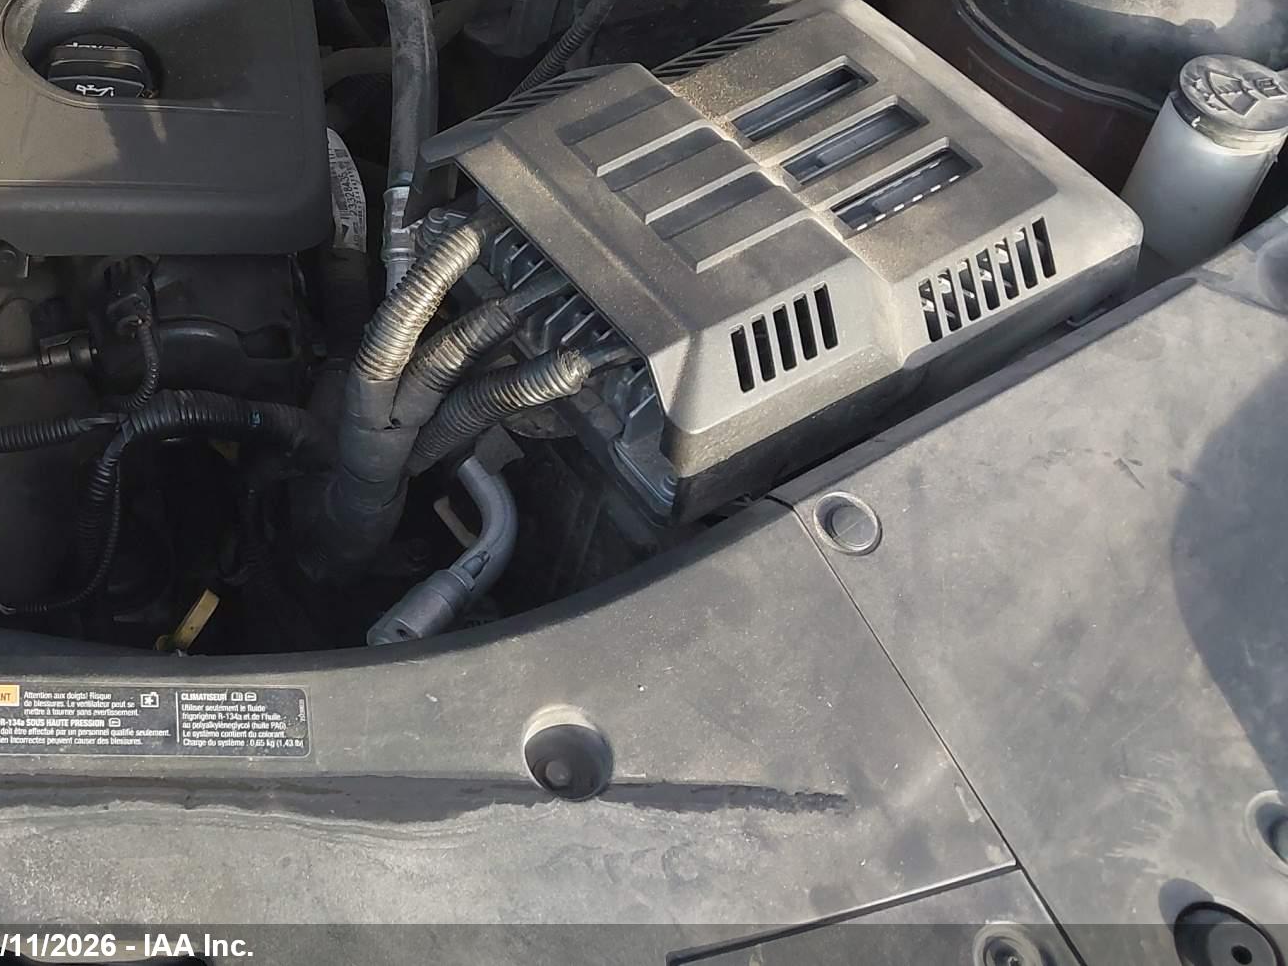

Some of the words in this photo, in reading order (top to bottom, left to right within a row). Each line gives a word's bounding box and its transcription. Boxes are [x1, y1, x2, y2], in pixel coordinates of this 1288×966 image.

[90, 692, 111, 700] Risque
[0, 718, 25, 726] R-134a
[70, 719, 104, 727] PRESSION
[78, 728, 109, 736] personnel
[267, 740, 275, 748] kg
